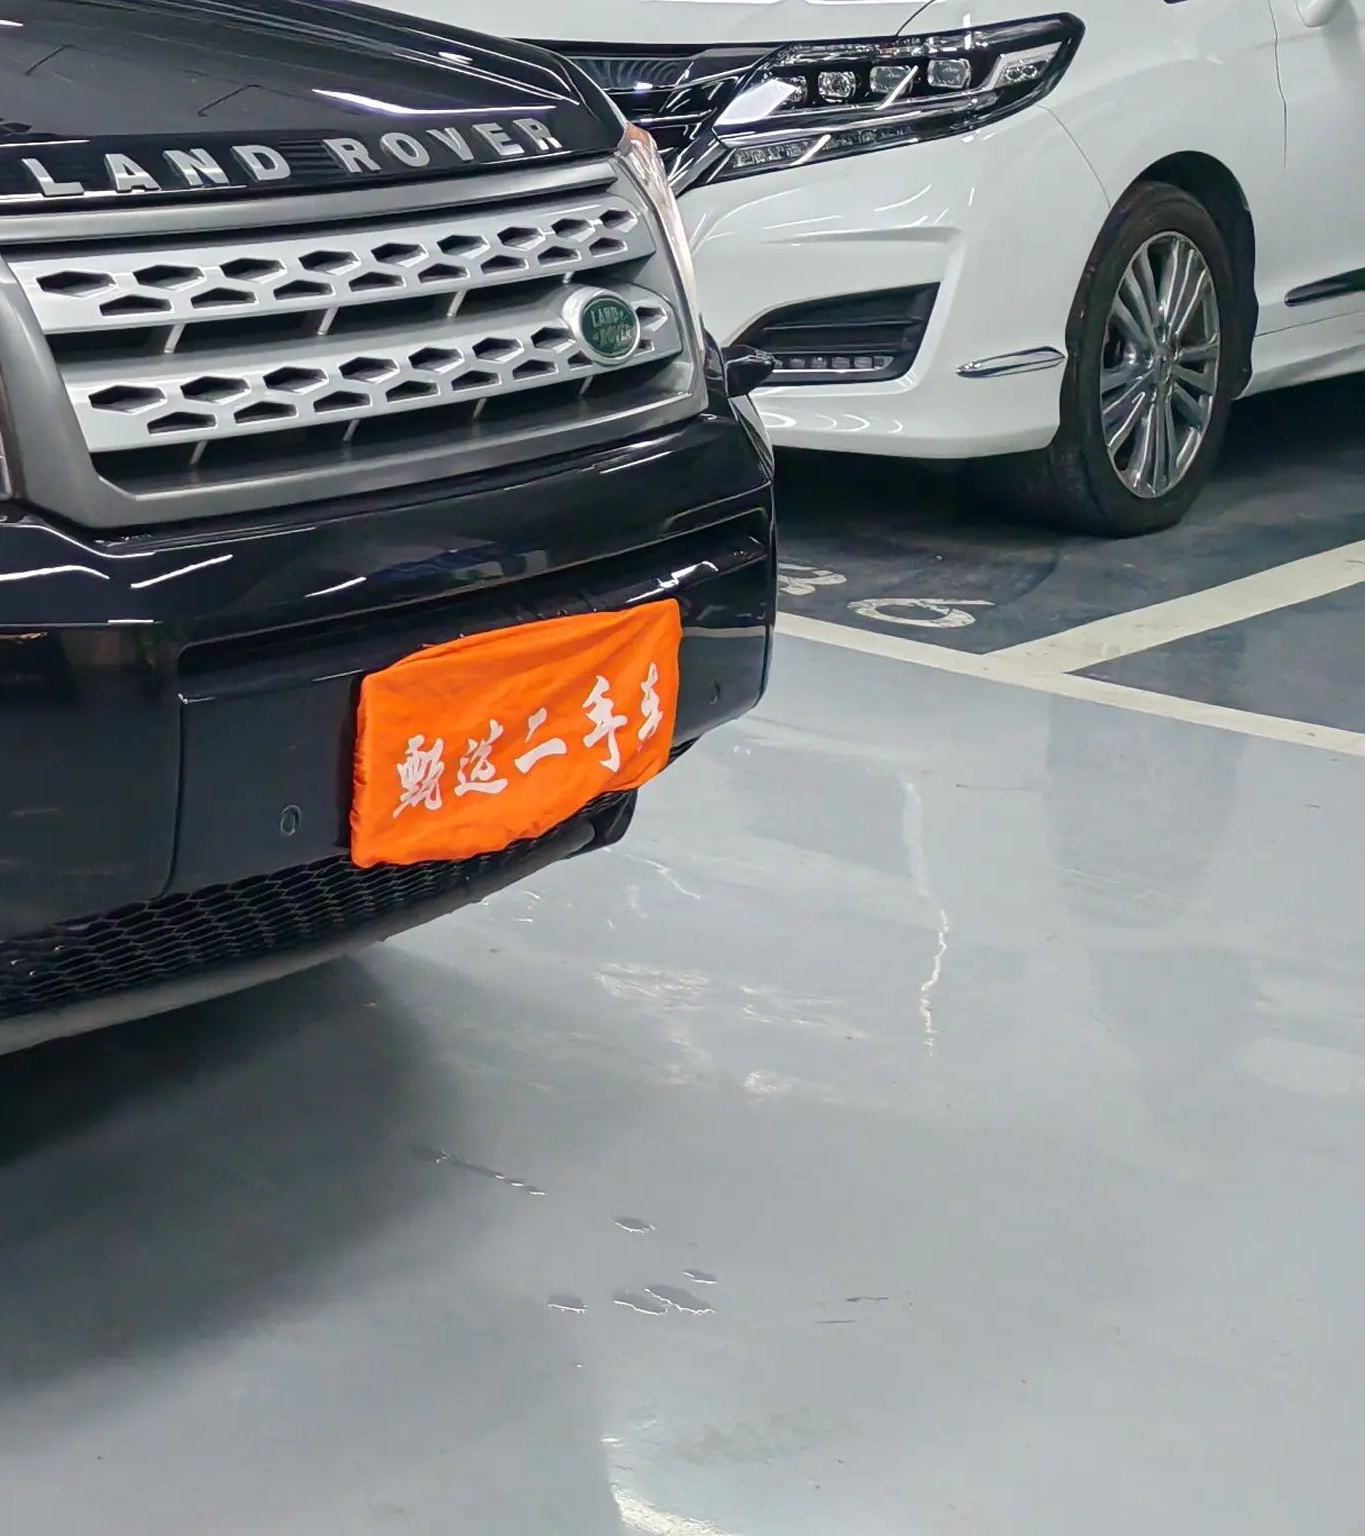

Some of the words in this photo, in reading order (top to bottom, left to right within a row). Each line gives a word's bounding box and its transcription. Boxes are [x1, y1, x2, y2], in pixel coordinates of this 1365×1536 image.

[22, 144, 292, 197] LAND
[323, 117, 563, 174] ROVER
[590, 306, 620, 327] LAND
[598, 323, 633, 346] ROVER
